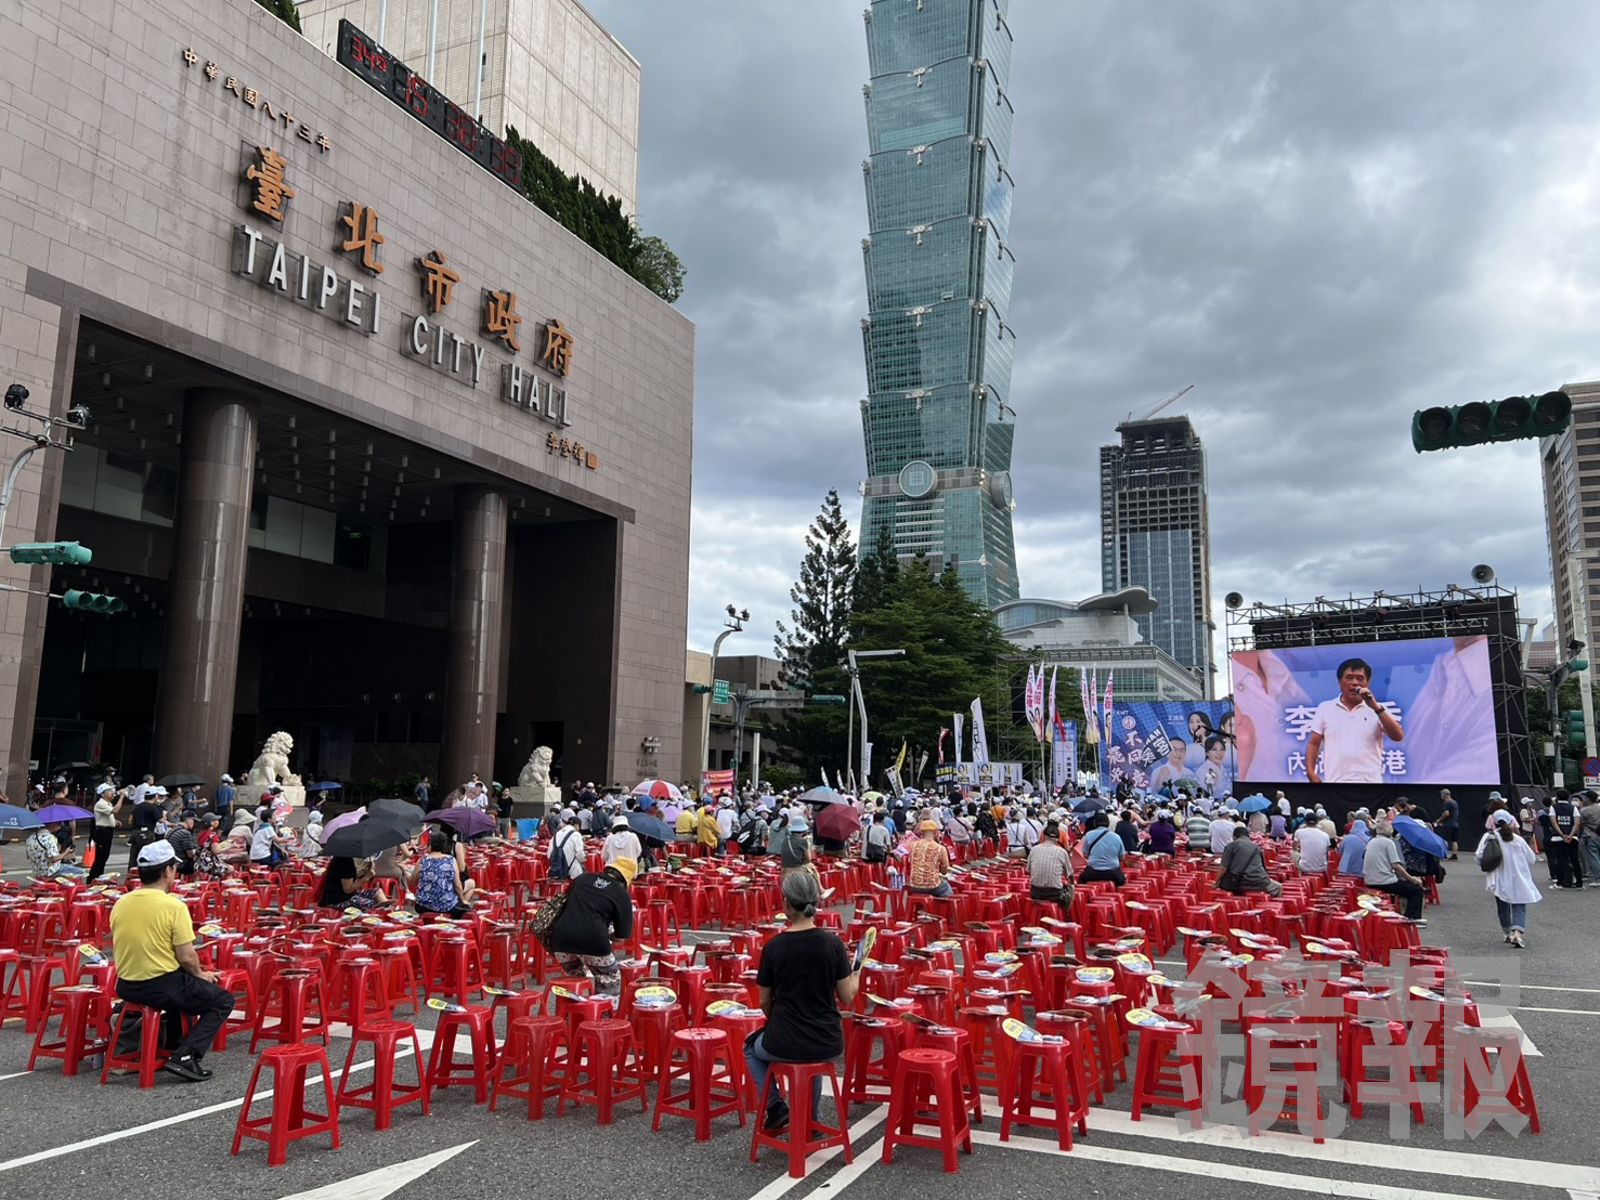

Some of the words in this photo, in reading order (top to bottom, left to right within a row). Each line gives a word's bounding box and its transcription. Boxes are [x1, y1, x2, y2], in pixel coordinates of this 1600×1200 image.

[182, 47, 332, 153] 中華民國八十三年
[240, 224, 382, 335] TAIPEI
[410, 314, 486, 384] CITY
[508, 362, 573, 428] HALL
[246, 145, 576, 377] 臺北市政府
